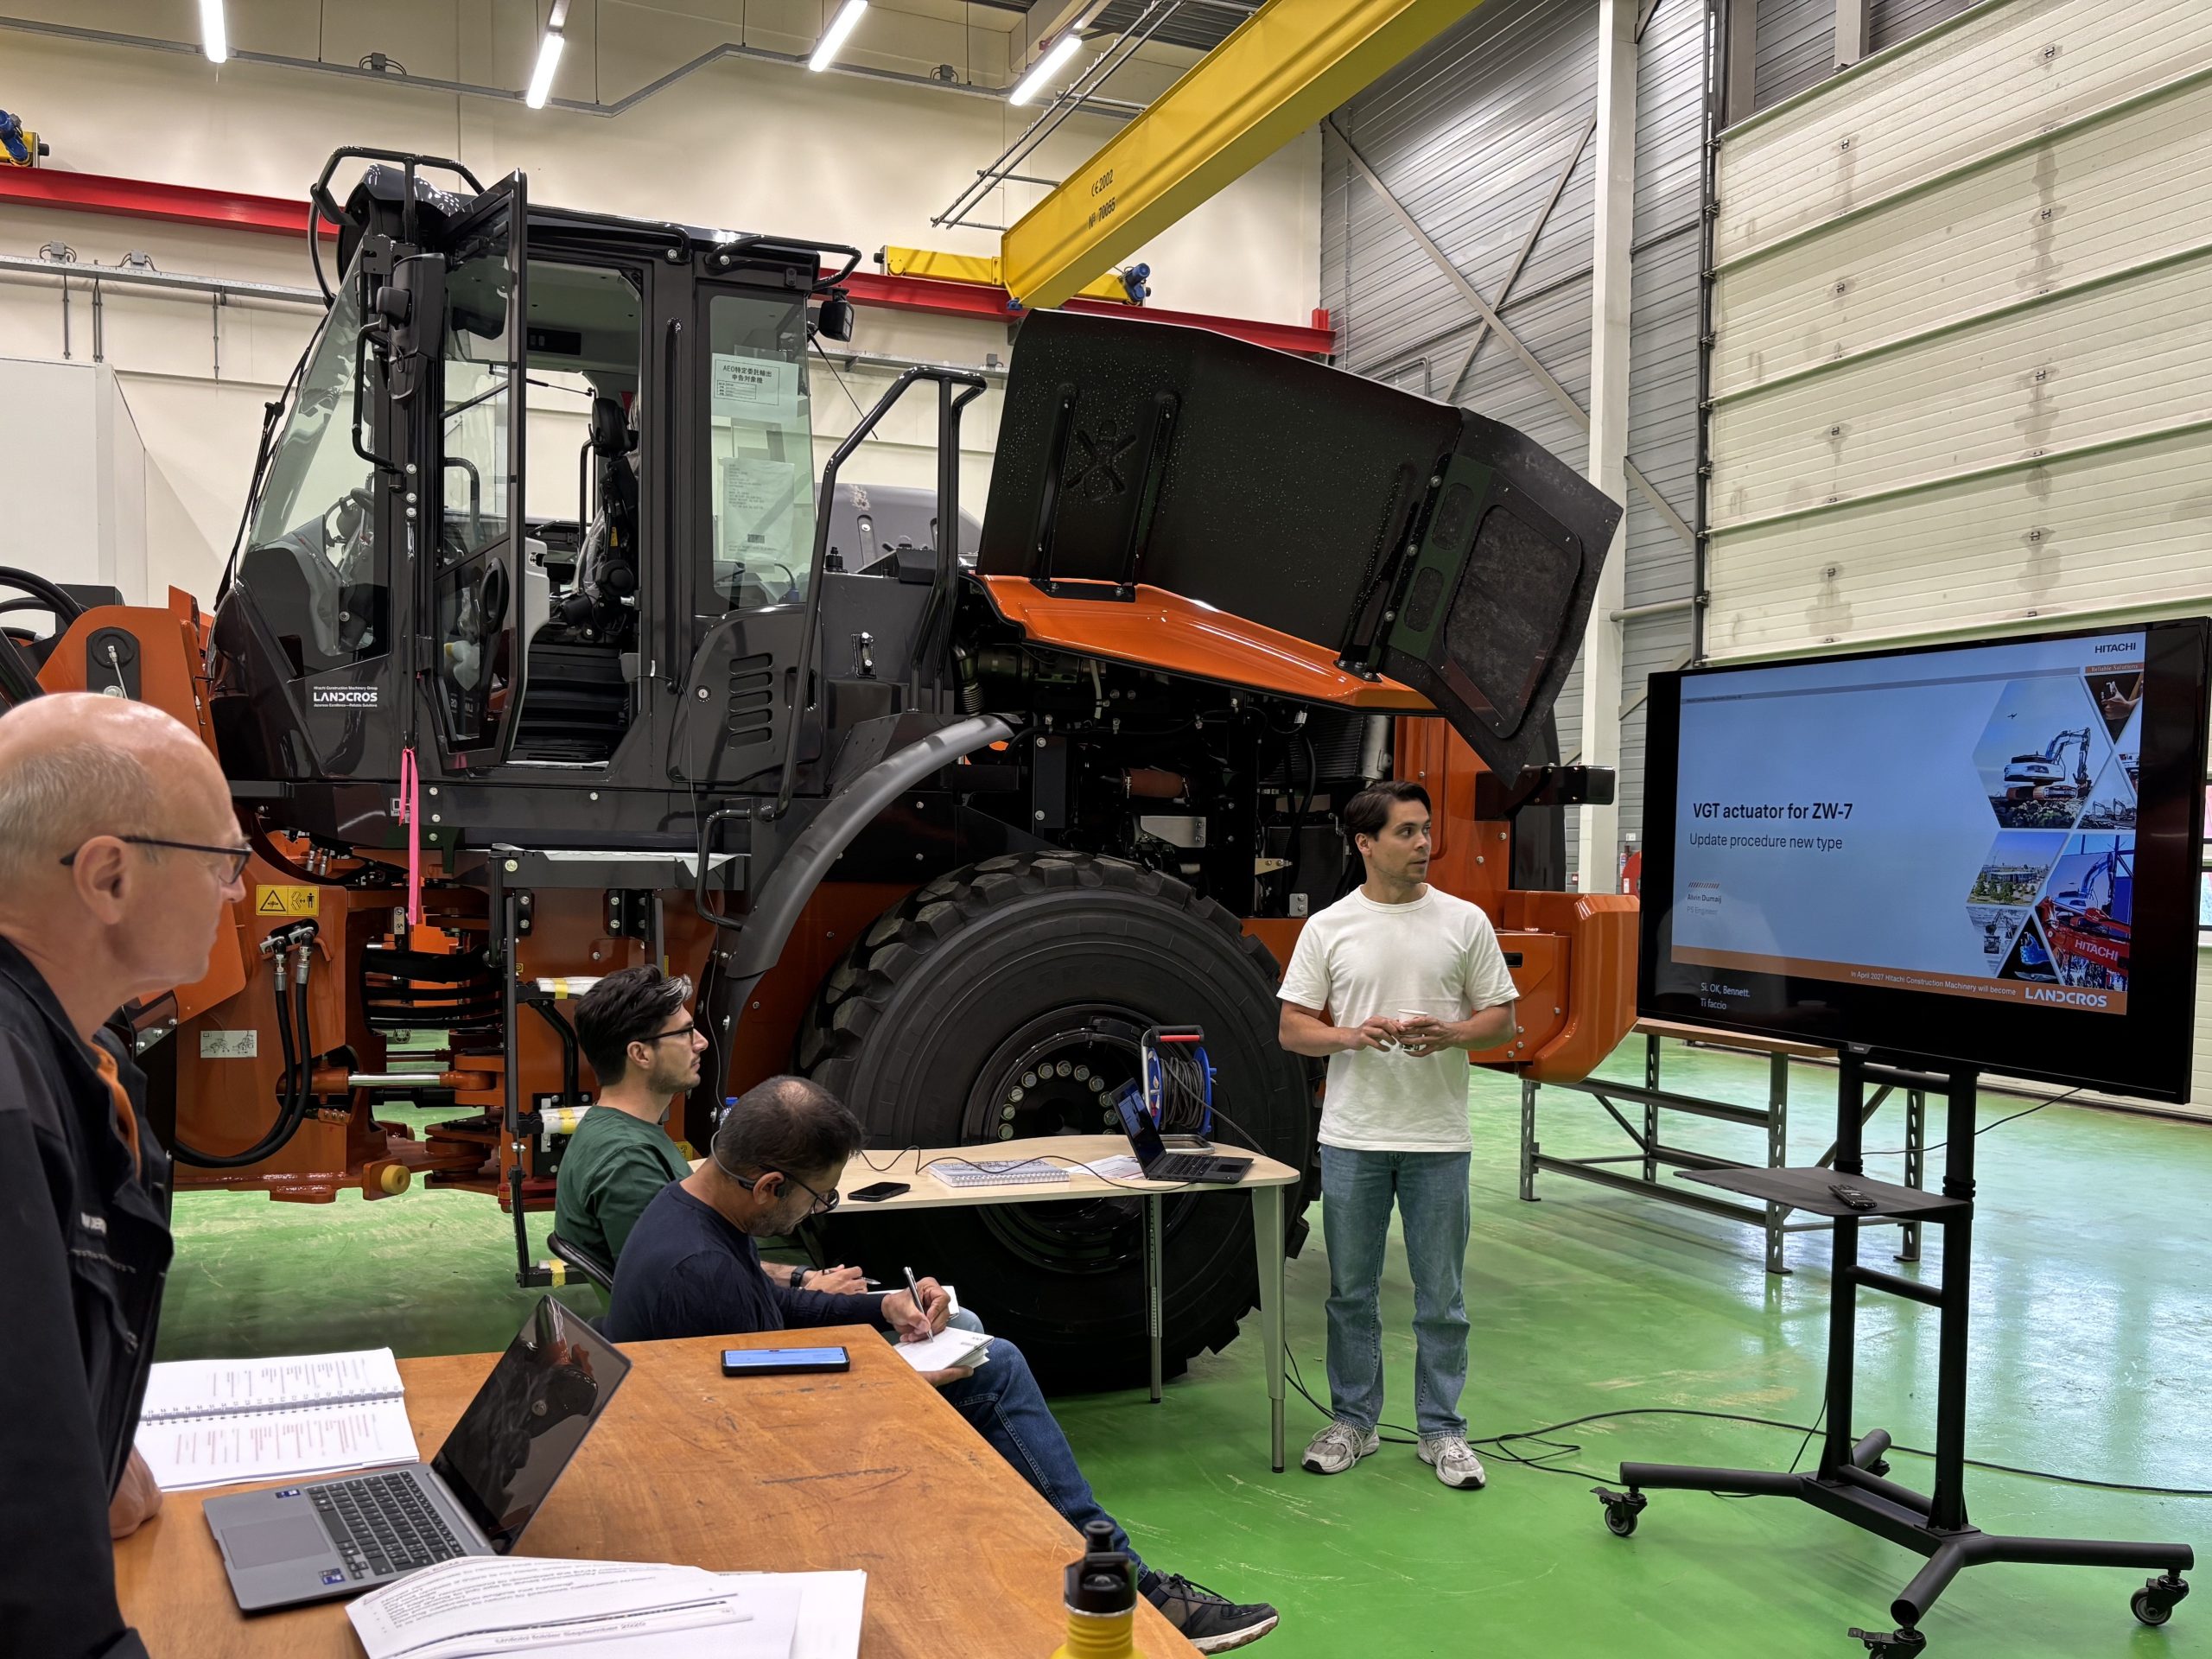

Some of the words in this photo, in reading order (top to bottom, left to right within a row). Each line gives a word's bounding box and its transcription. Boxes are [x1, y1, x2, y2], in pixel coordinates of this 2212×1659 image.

[2094, 642, 2136, 654] HITACHI
[314, 692, 378, 702] LANDCROS
[1693, 803, 1720, 818] VGT
[1723, 804, 1784, 819] actuator
[1788, 803, 1809, 819] for
[1812, 803, 1853, 819] ZW-7
[1689, 833, 1728, 849] Update
[1730, 835, 1787, 849] procedure
[1789, 837, 1814, 849] new
[1816, 837, 1843, 852] type
[2075, 939, 2119, 962] HITACHI
[1710, 983, 1722, 995] OK,
[1723, 985, 1750, 996] Bennett.
[1857, 970, 1870, 980] April
[1885, 974, 1905, 982] Hitachi
[1906, 976, 1944, 987] Construction
[1944, 981, 1977, 992] Machinery
[1990, 985, 2017, 995] become
[1700, 997, 1707, 1007] Ti
[1707, 998, 1727, 1009] faccio
[2024, 987, 2108, 1008] LANDCROS
